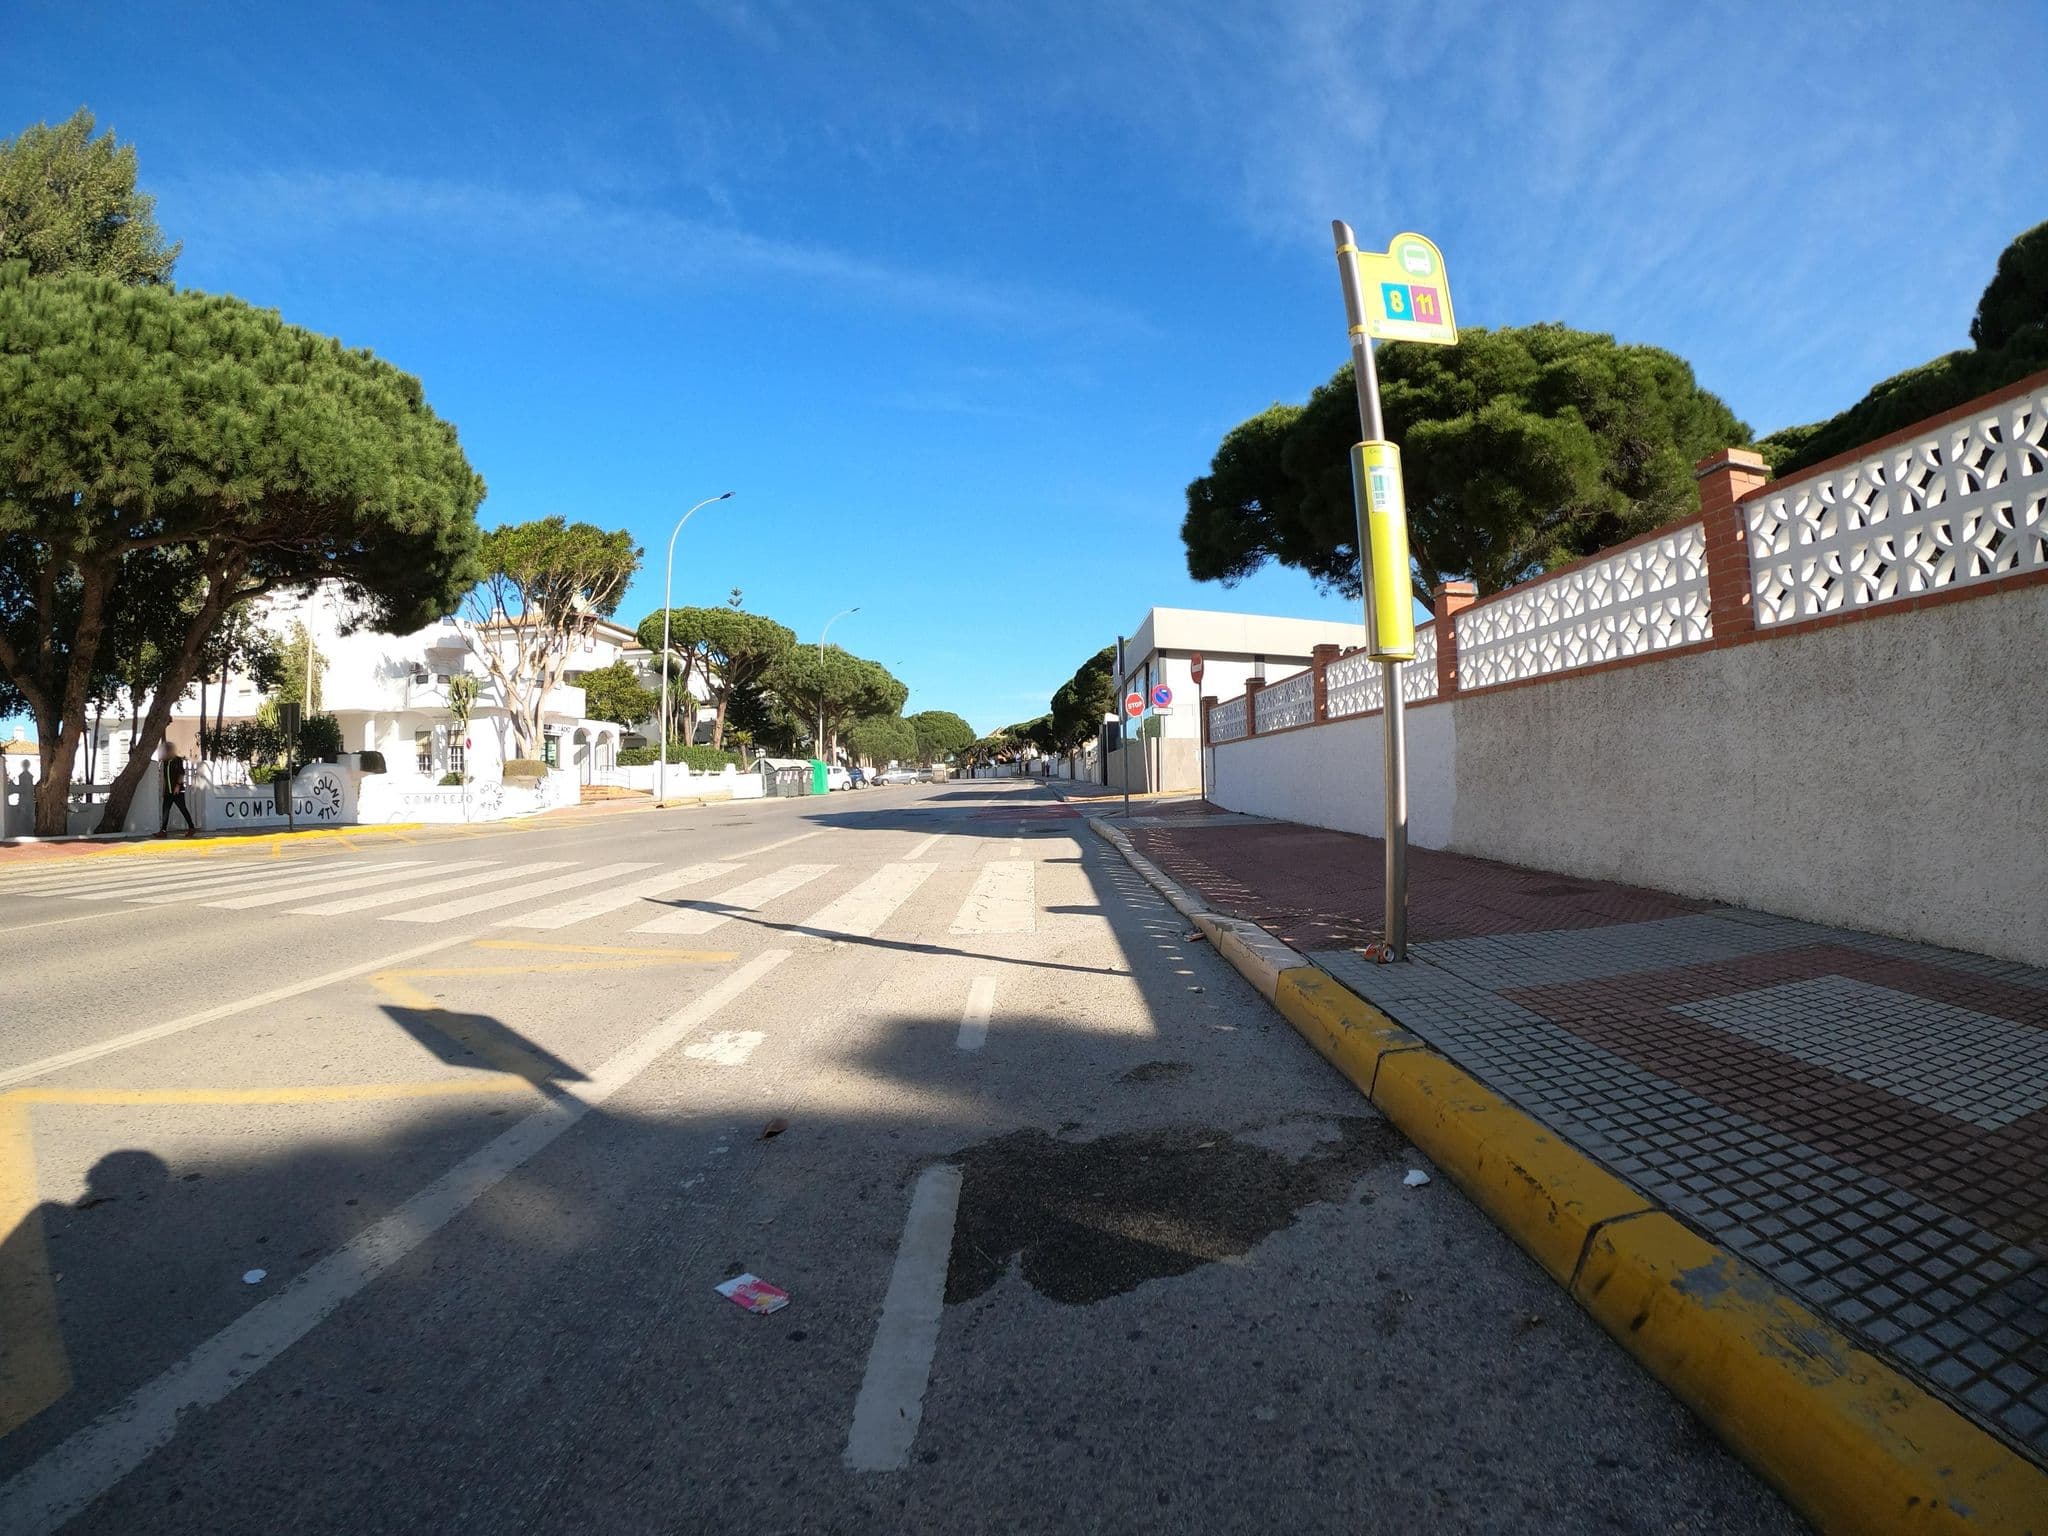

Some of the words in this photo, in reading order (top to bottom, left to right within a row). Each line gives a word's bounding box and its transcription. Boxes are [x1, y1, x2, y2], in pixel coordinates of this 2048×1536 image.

[1390, 290, 1405, 313] 8
[1416, 293, 1435, 316] 11
[1127, 701, 1142, 710] STOP
[225, 800, 313, 818] COMPJO
